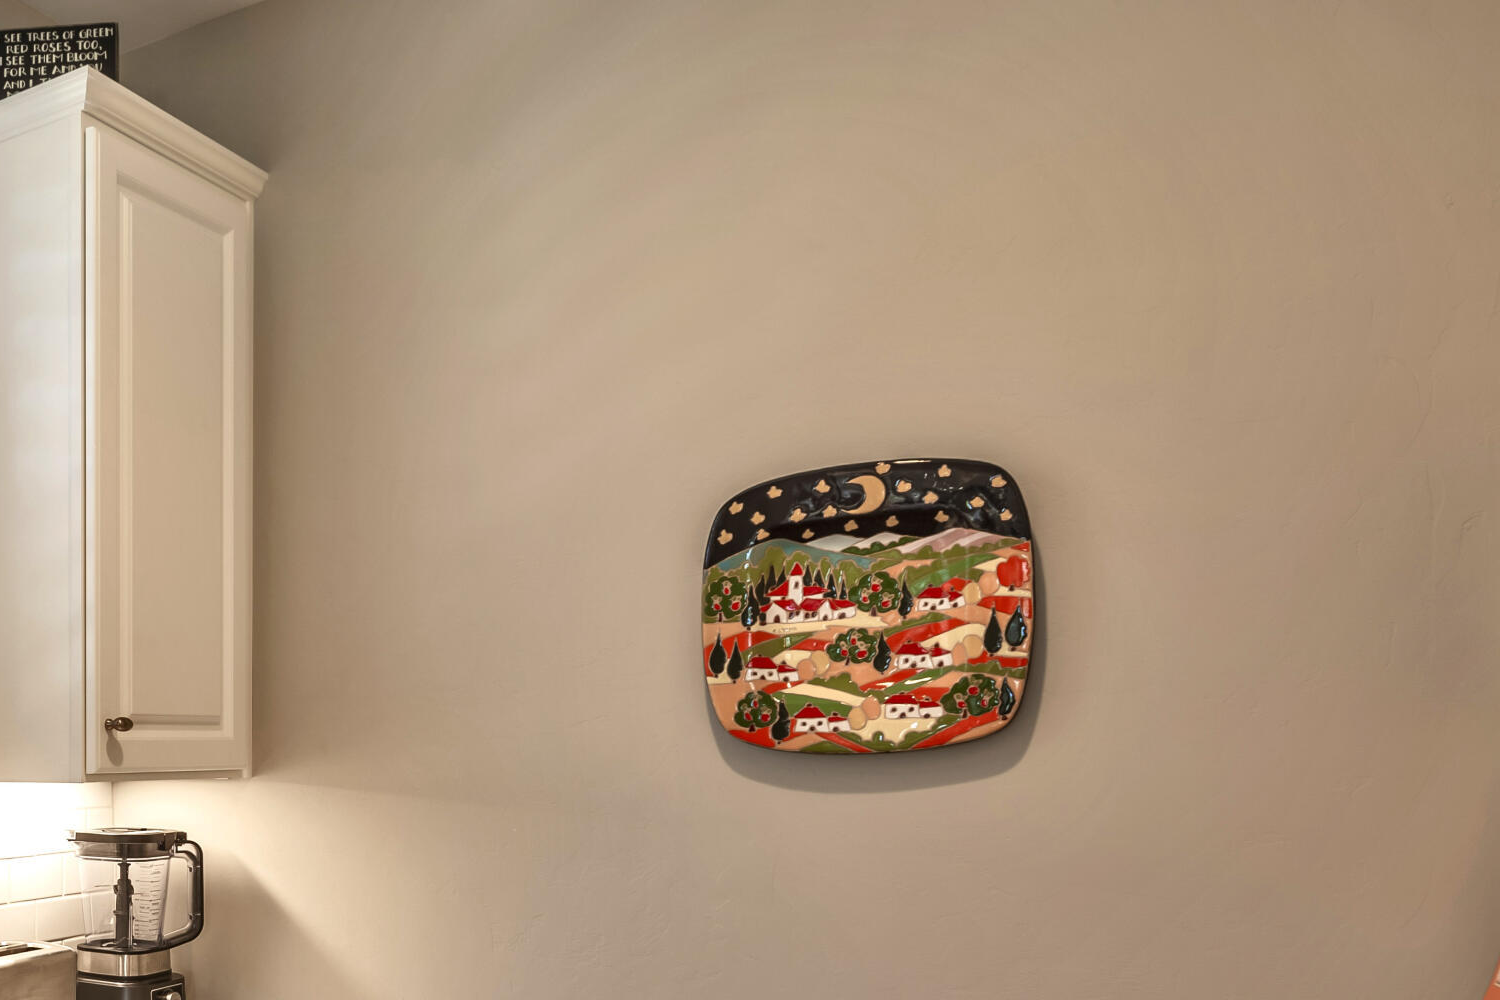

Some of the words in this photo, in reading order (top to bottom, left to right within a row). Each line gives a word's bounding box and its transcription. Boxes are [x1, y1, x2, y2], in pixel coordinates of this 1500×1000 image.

[4, 33, 22, 43] SEE
[27, 31, 59, 42] TREES
[62, 30, 75, 40] OF
[79, 27, 114, 39] GREEN
[6, 44, 29, 54] RED
[33, 42, 71, 53] ROSES
[76, 40, 103, 51] TOO,
[0, 56, 3, 66] I
[6, 55, 25, 66] SEE
[30, 53, 64, 65] THEM
[66, 51, 108, 63] BLOOM
[3, 67, 27, 78] FOR
[29, 66, 47, 76] ME
[3, 80, 26, 90] AND
